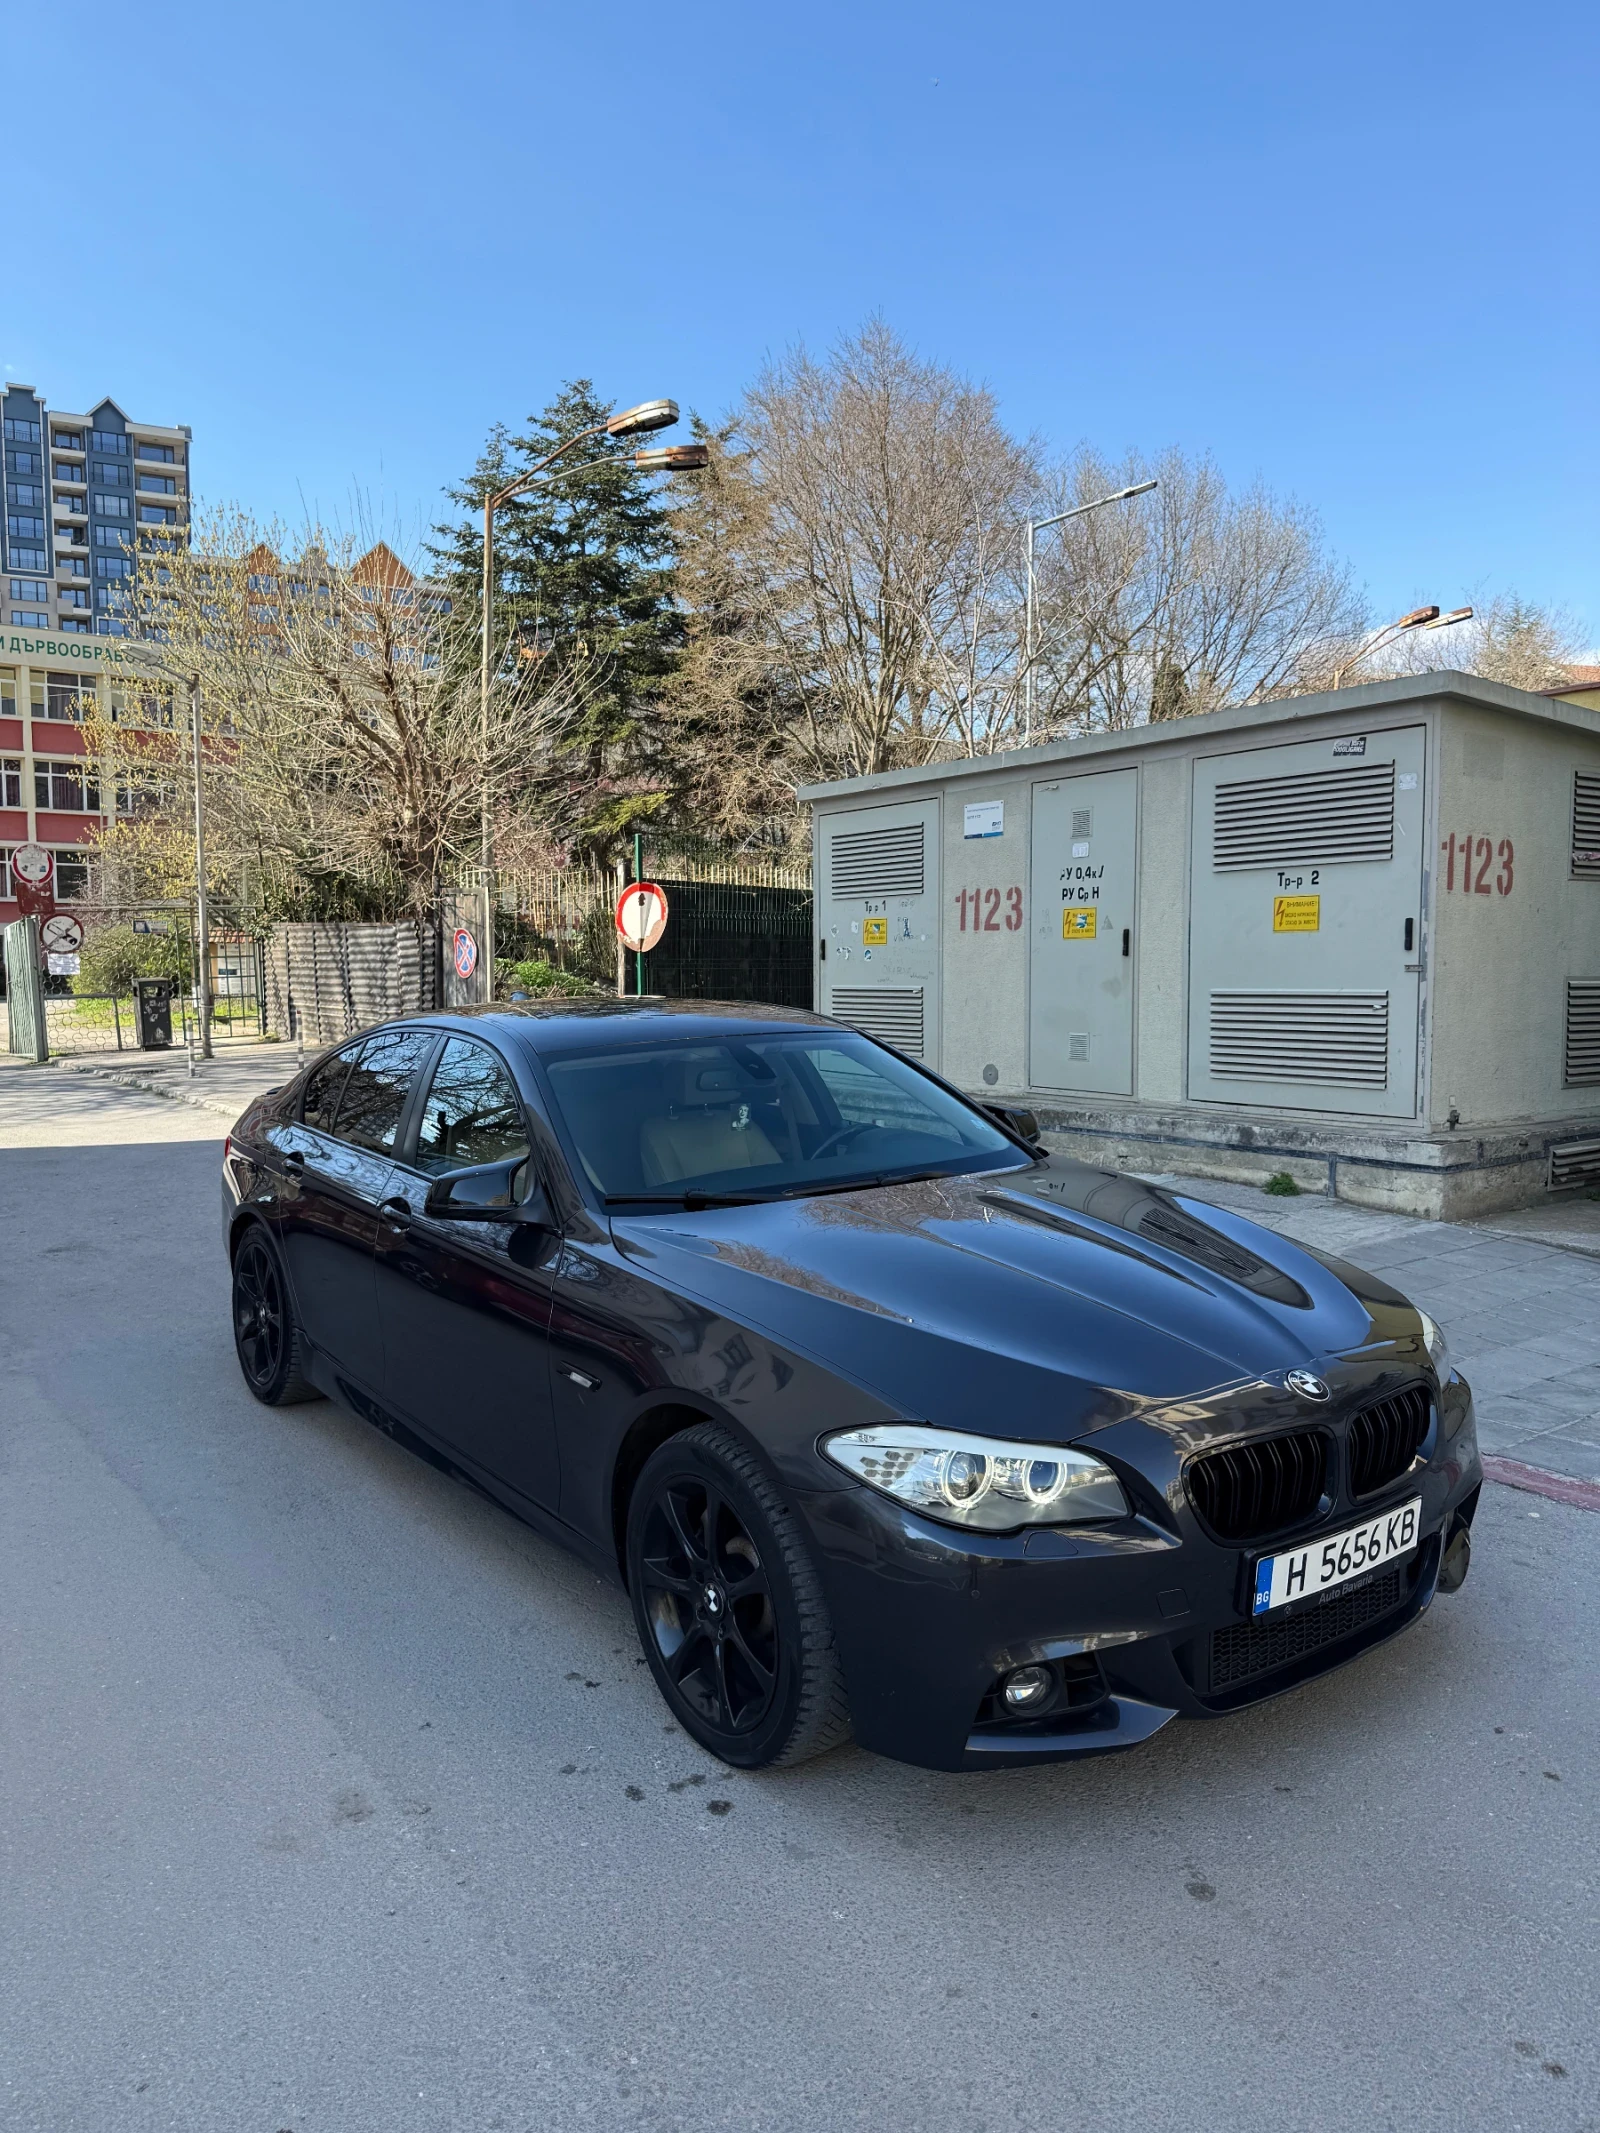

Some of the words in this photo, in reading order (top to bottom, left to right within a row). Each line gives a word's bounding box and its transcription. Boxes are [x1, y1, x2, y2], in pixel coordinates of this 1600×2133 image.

[1277, 872, 1303, 890] Тр-р
[1311, 870, 1319, 885] 2
[1441, 832, 1514, 896] 1123
[955, 886, 1023, 931] 1123
[1062, 887, 1075, 900] РУ
[1286, 1553, 1308, 1597] H
[1318, 1587, 1341, 1605] Auto
[1341, 1573, 1374, 1595] Bavaria
[1255, 1591, 1270, 1606] BG
